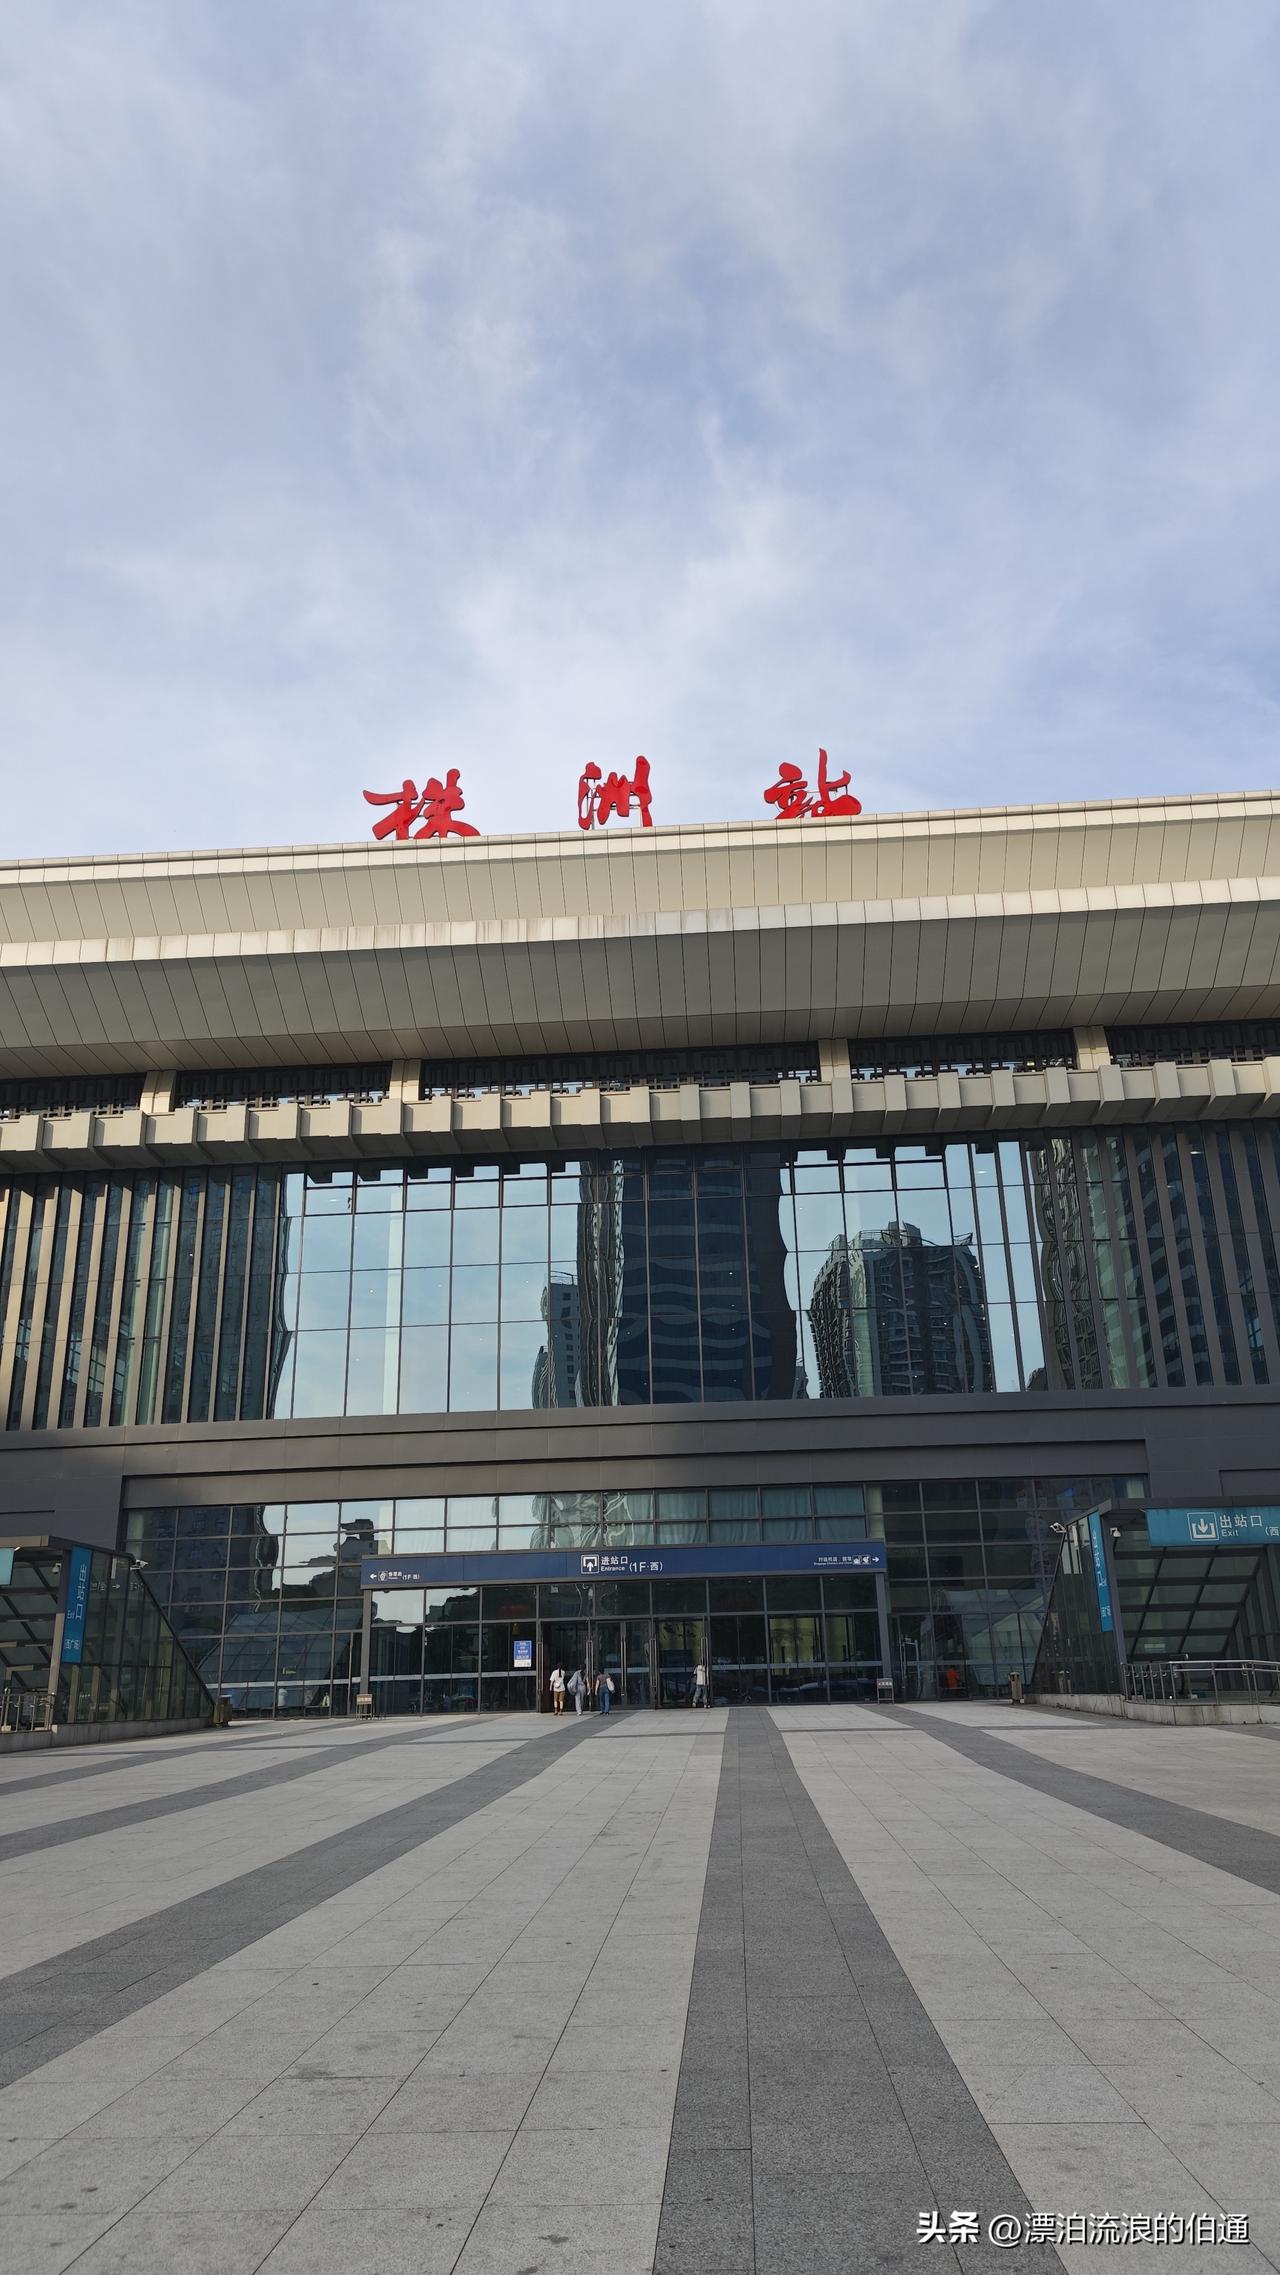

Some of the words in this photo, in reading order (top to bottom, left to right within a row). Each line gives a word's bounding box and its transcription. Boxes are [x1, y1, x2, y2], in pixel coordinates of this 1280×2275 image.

[1219, 1514, 1263, 1528] 出站口
[1221, 1528, 1239, 1537] Exit
[600, 1556, 628, 1566] 进站口
